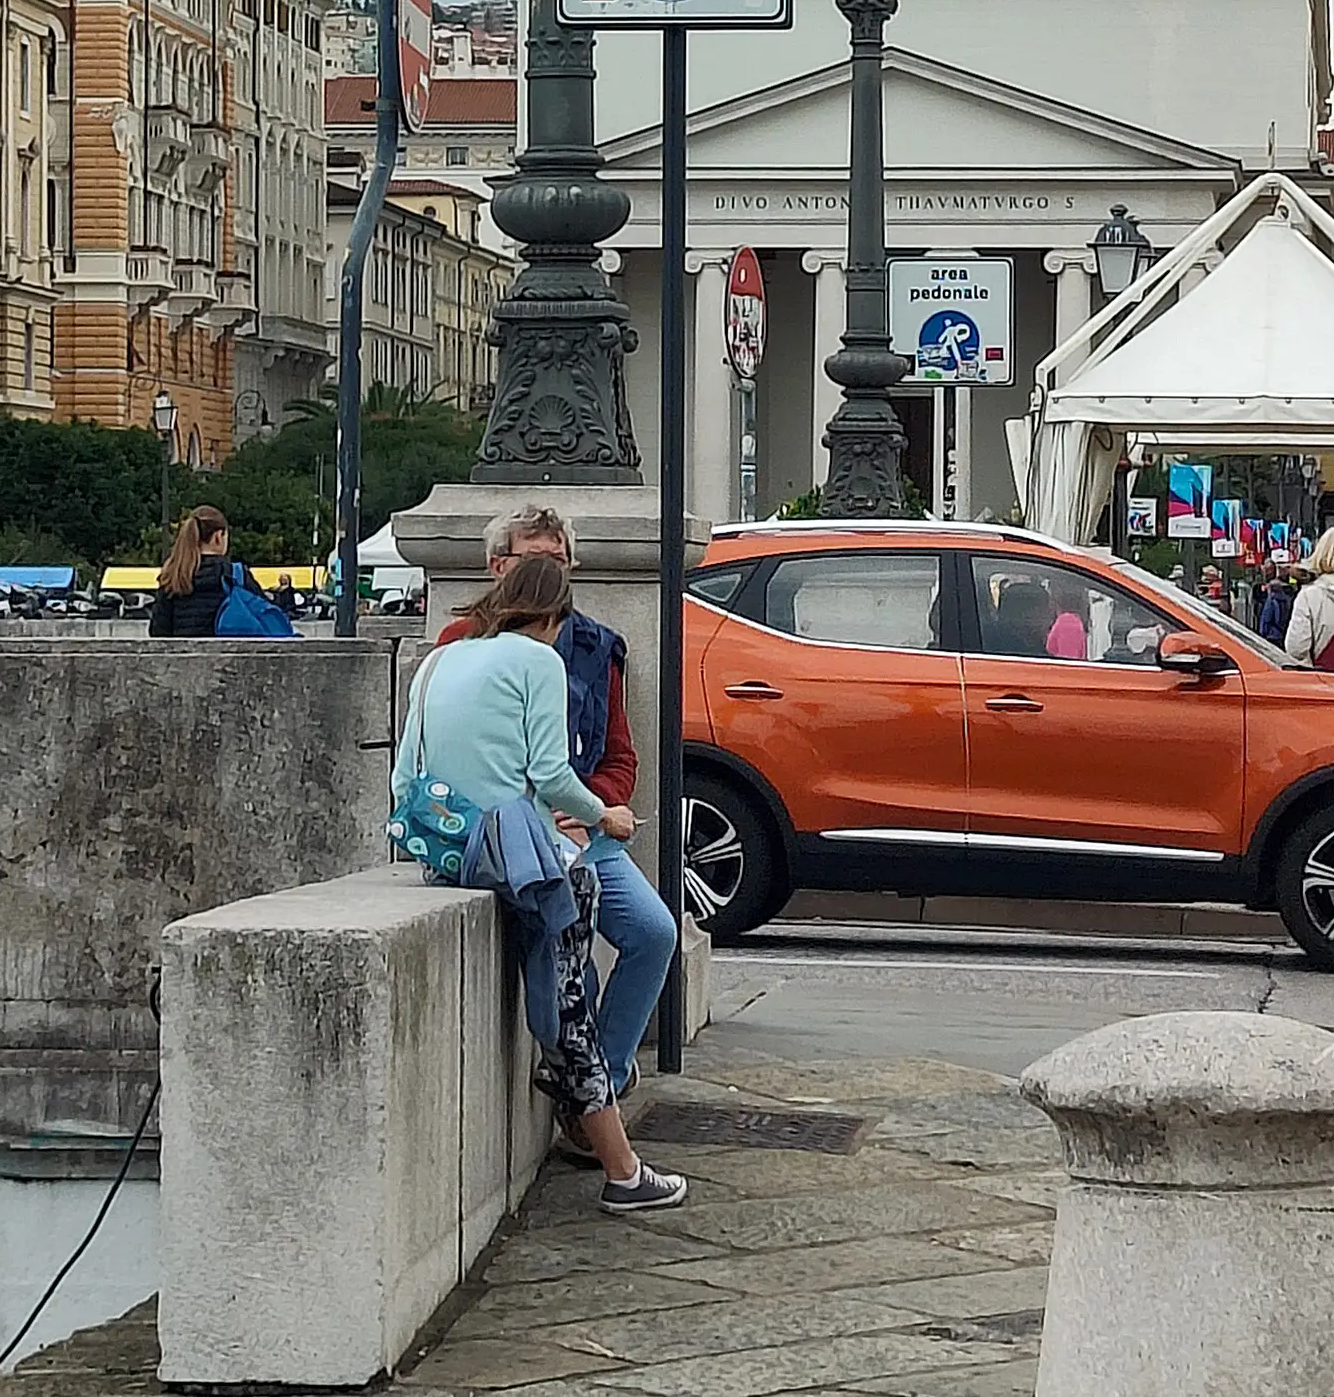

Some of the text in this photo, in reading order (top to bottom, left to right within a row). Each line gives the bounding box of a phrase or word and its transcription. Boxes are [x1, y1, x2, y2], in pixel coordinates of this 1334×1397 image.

[715, 195, 768, 210] DIVO
[930, 269, 969, 281] area
[910, 284, 990, 303] pedonale
